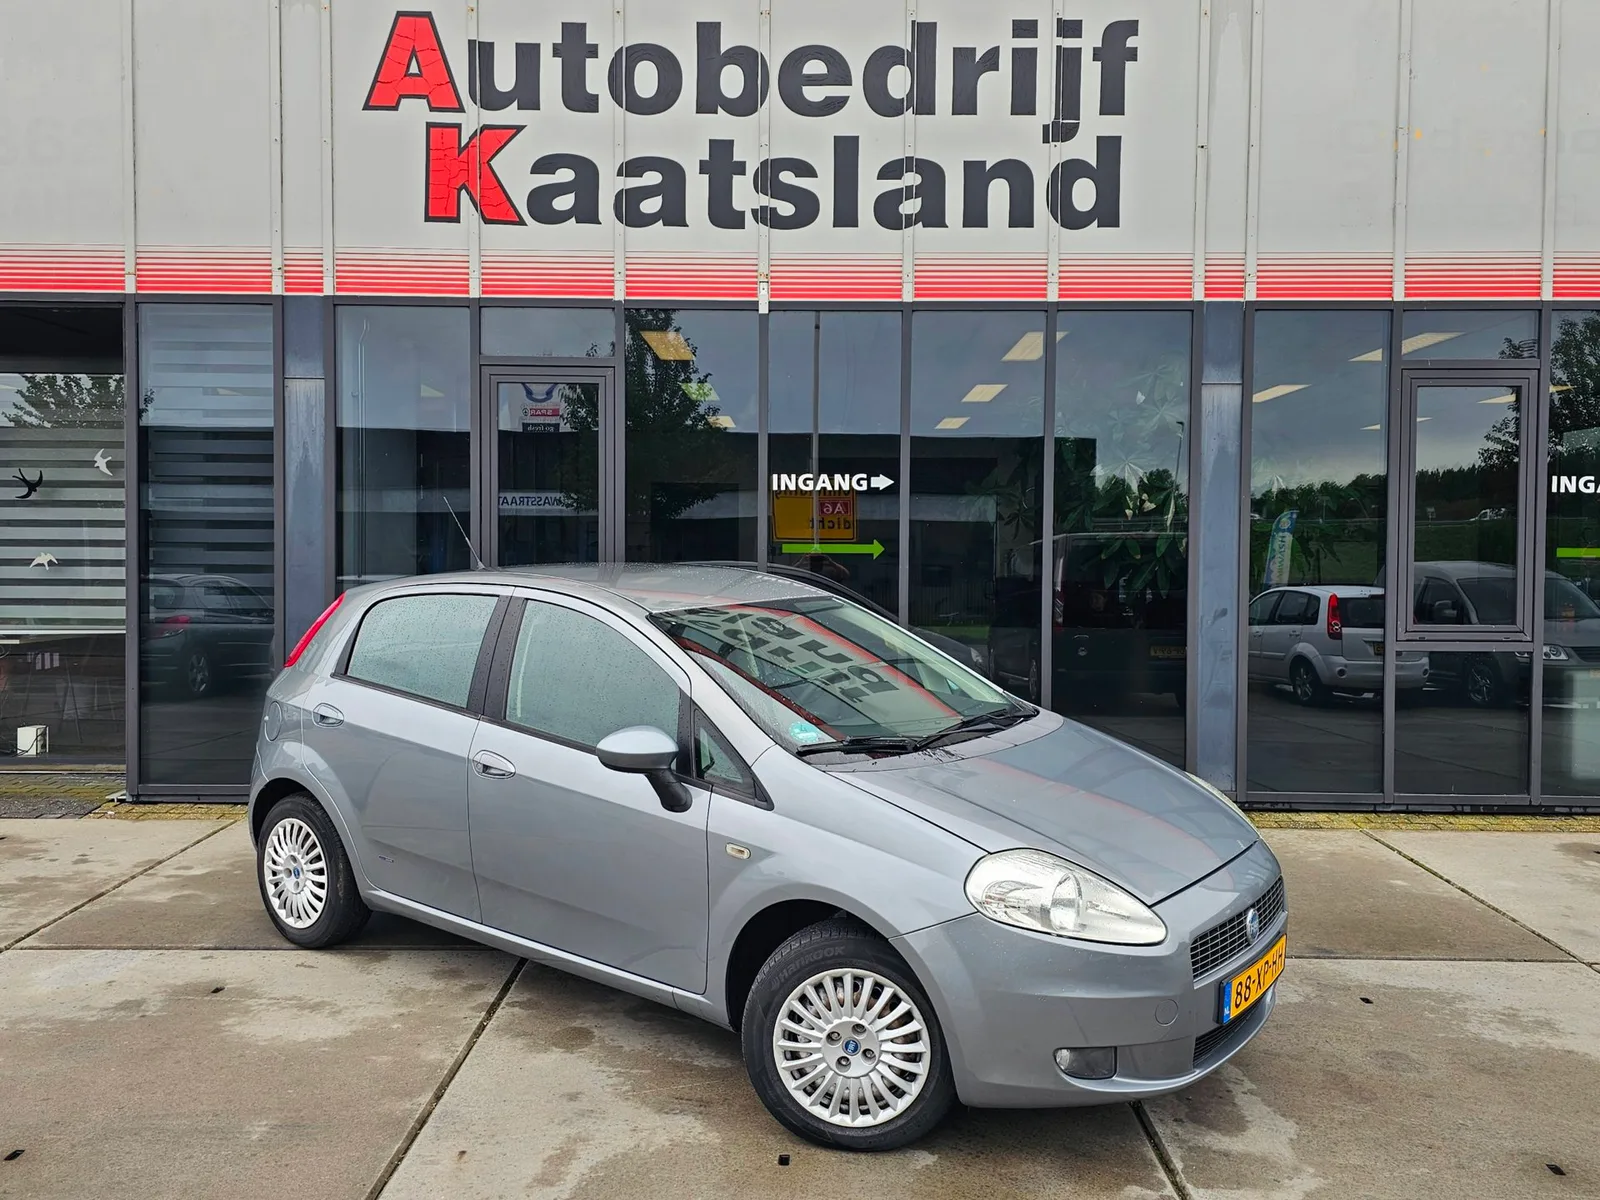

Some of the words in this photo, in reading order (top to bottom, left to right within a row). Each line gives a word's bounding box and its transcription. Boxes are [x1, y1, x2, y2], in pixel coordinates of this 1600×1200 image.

[362, 11, 1139, 143] Autobedrijf
[424, 122, 1122, 230] Kaatsland
[772, 473, 868, 491] INGANG
[1234, 942, 1284, 1009] 88-XP-HH
